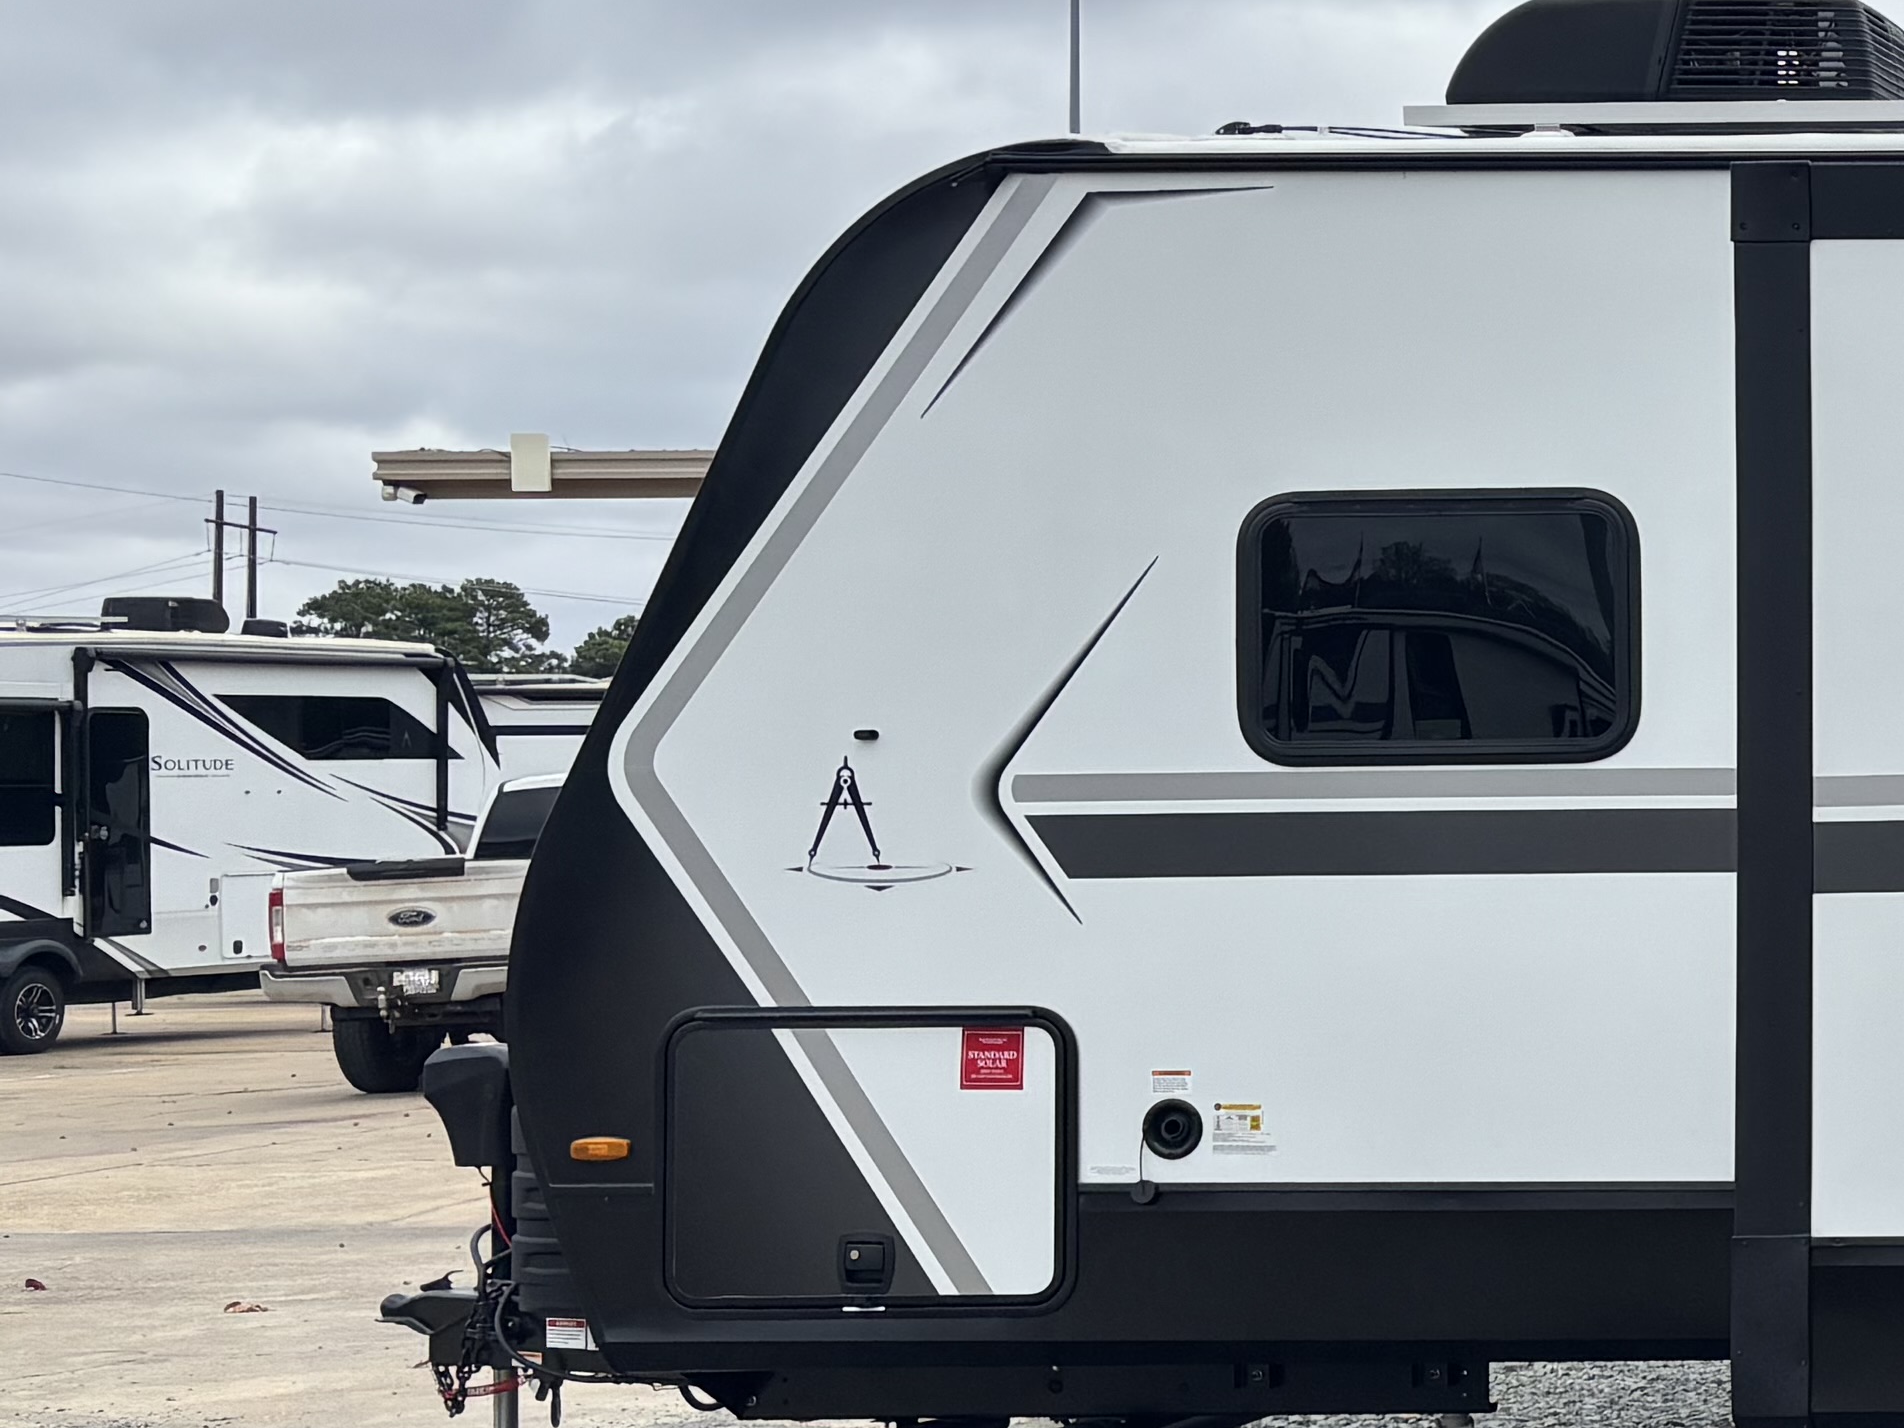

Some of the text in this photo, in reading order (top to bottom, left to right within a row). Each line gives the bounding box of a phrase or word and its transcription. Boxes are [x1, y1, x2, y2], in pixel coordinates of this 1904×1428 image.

[150, 755, 235, 771] SOLITUDE
[967, 1050, 1018, 1060] STANDARD
[977, 1059, 1008, 1068] SOLAR
